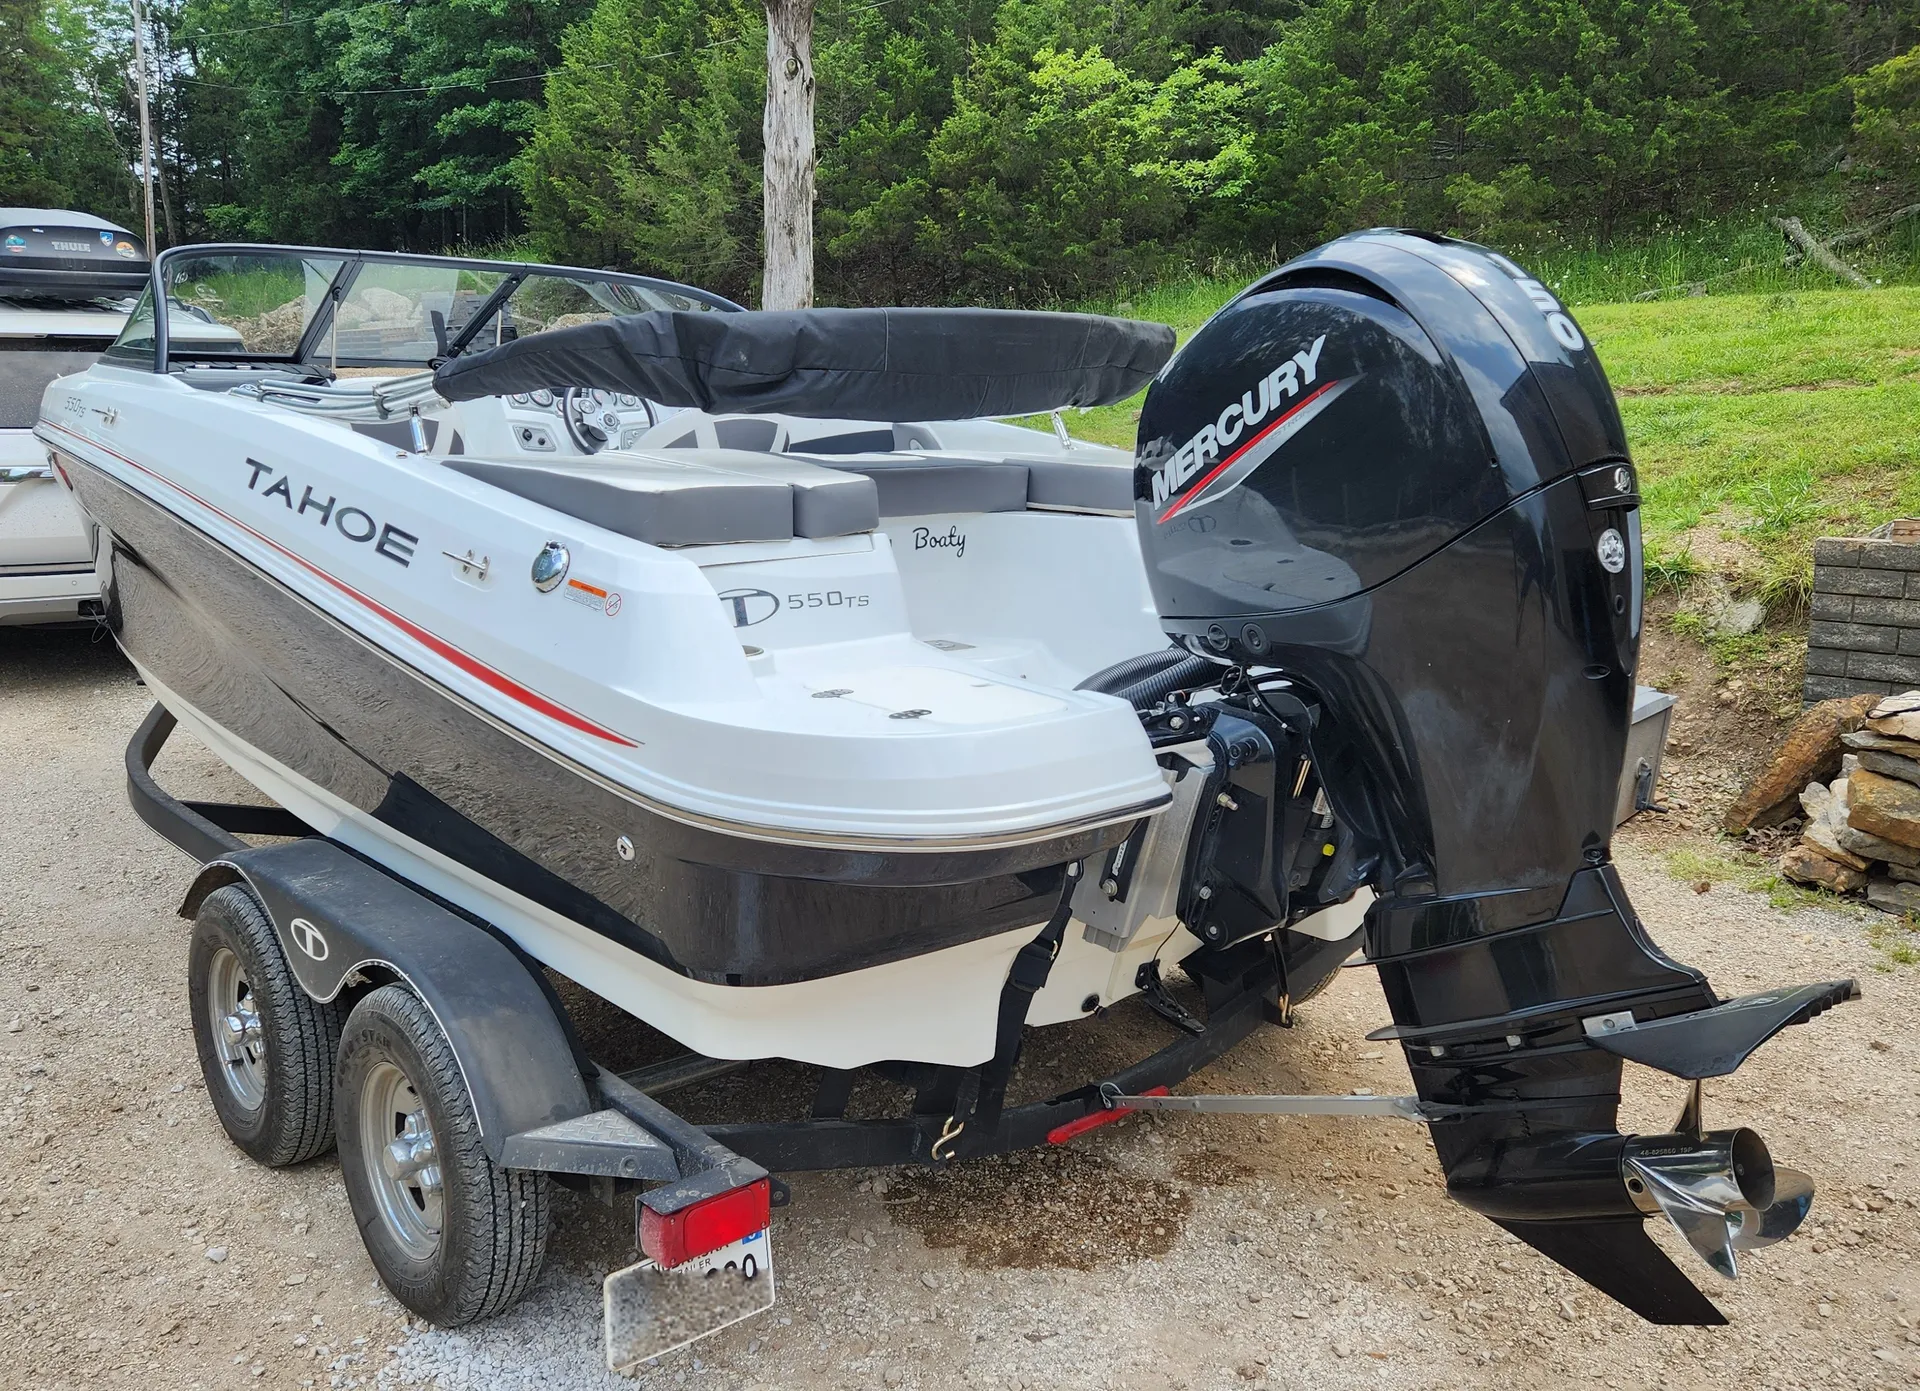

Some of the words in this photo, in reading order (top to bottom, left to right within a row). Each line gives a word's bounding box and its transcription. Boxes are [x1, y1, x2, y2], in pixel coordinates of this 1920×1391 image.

[51, 241, 91, 252] THULE
[1151, 334, 1327, 510] MERCURY
[245, 457, 419, 568] TAHOE
[912, 525, 966, 558] Boaty
